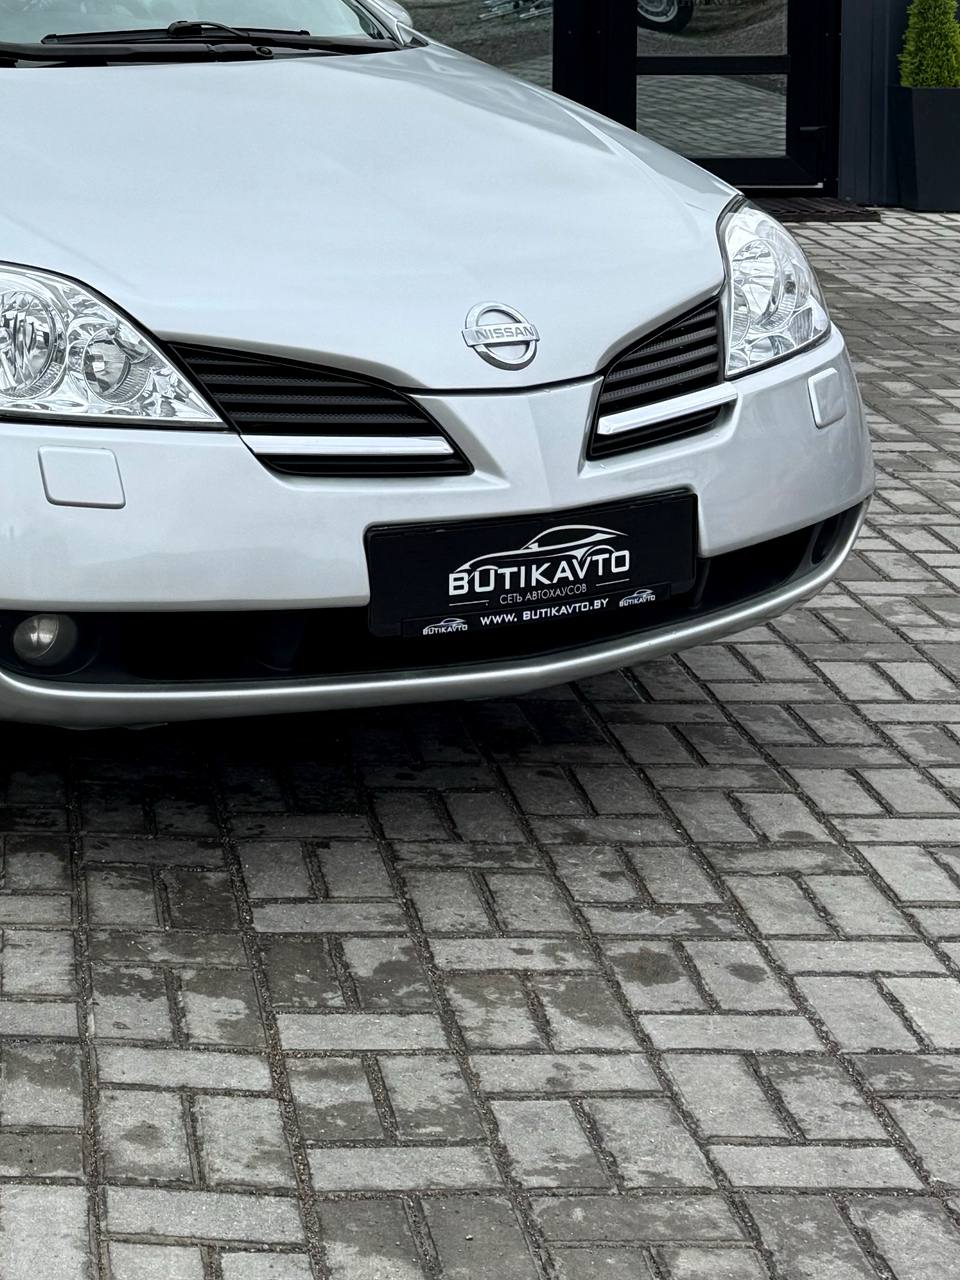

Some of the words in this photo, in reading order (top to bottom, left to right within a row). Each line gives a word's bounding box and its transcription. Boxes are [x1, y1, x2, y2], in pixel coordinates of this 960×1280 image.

[474, 326, 535, 340] NISSAN
[448, 549, 631, 597] BUTIKAVTO
[499, 593, 523, 606] СЕТЬ
[524, 583, 588, 602] АВТОХАУСОВ
[480, 612, 518, 626] WWW.
[522, 598, 610, 621] BUTIKAVTO.BY
[422, 624, 468, 636] BUTIKAVTO
